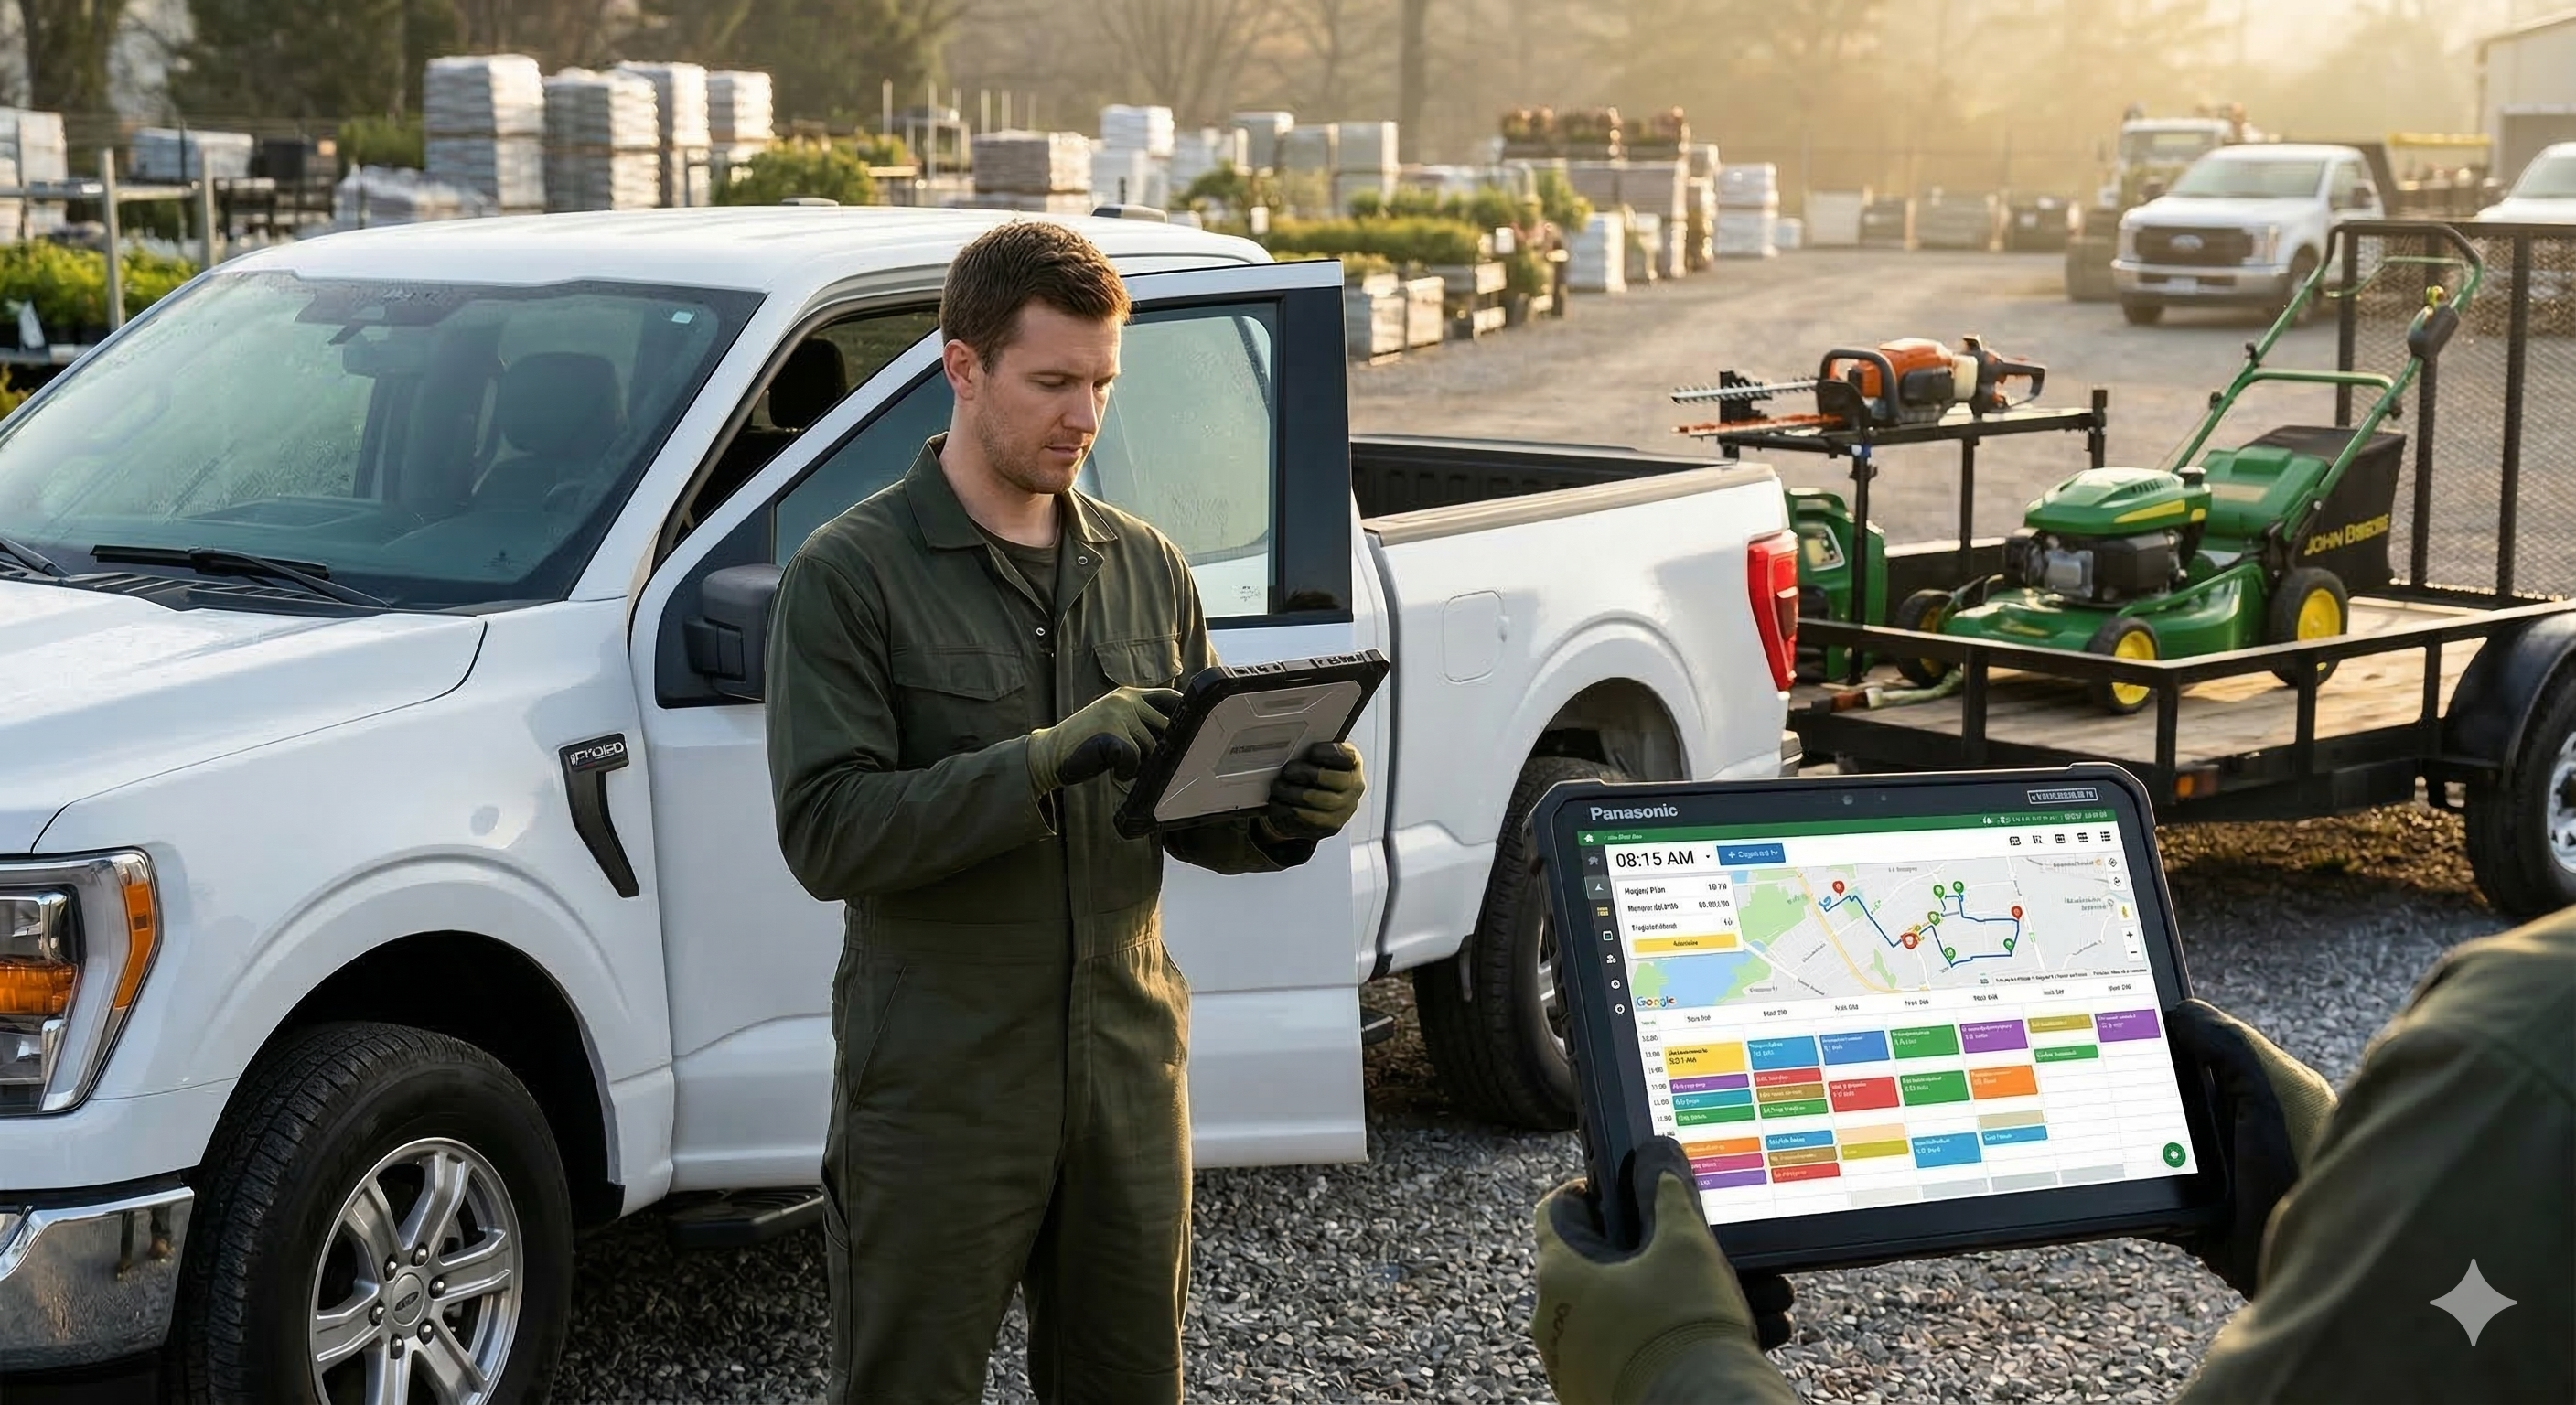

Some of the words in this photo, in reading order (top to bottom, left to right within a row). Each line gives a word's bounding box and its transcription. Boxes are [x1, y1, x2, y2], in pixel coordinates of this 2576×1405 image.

[2304, 529, 2343, 556] JOHN
[1590, 803, 1679, 820] Panasonic
[1615, 852, 1662, 867] 08:15
[1668, 850, 1694, 865] AM
